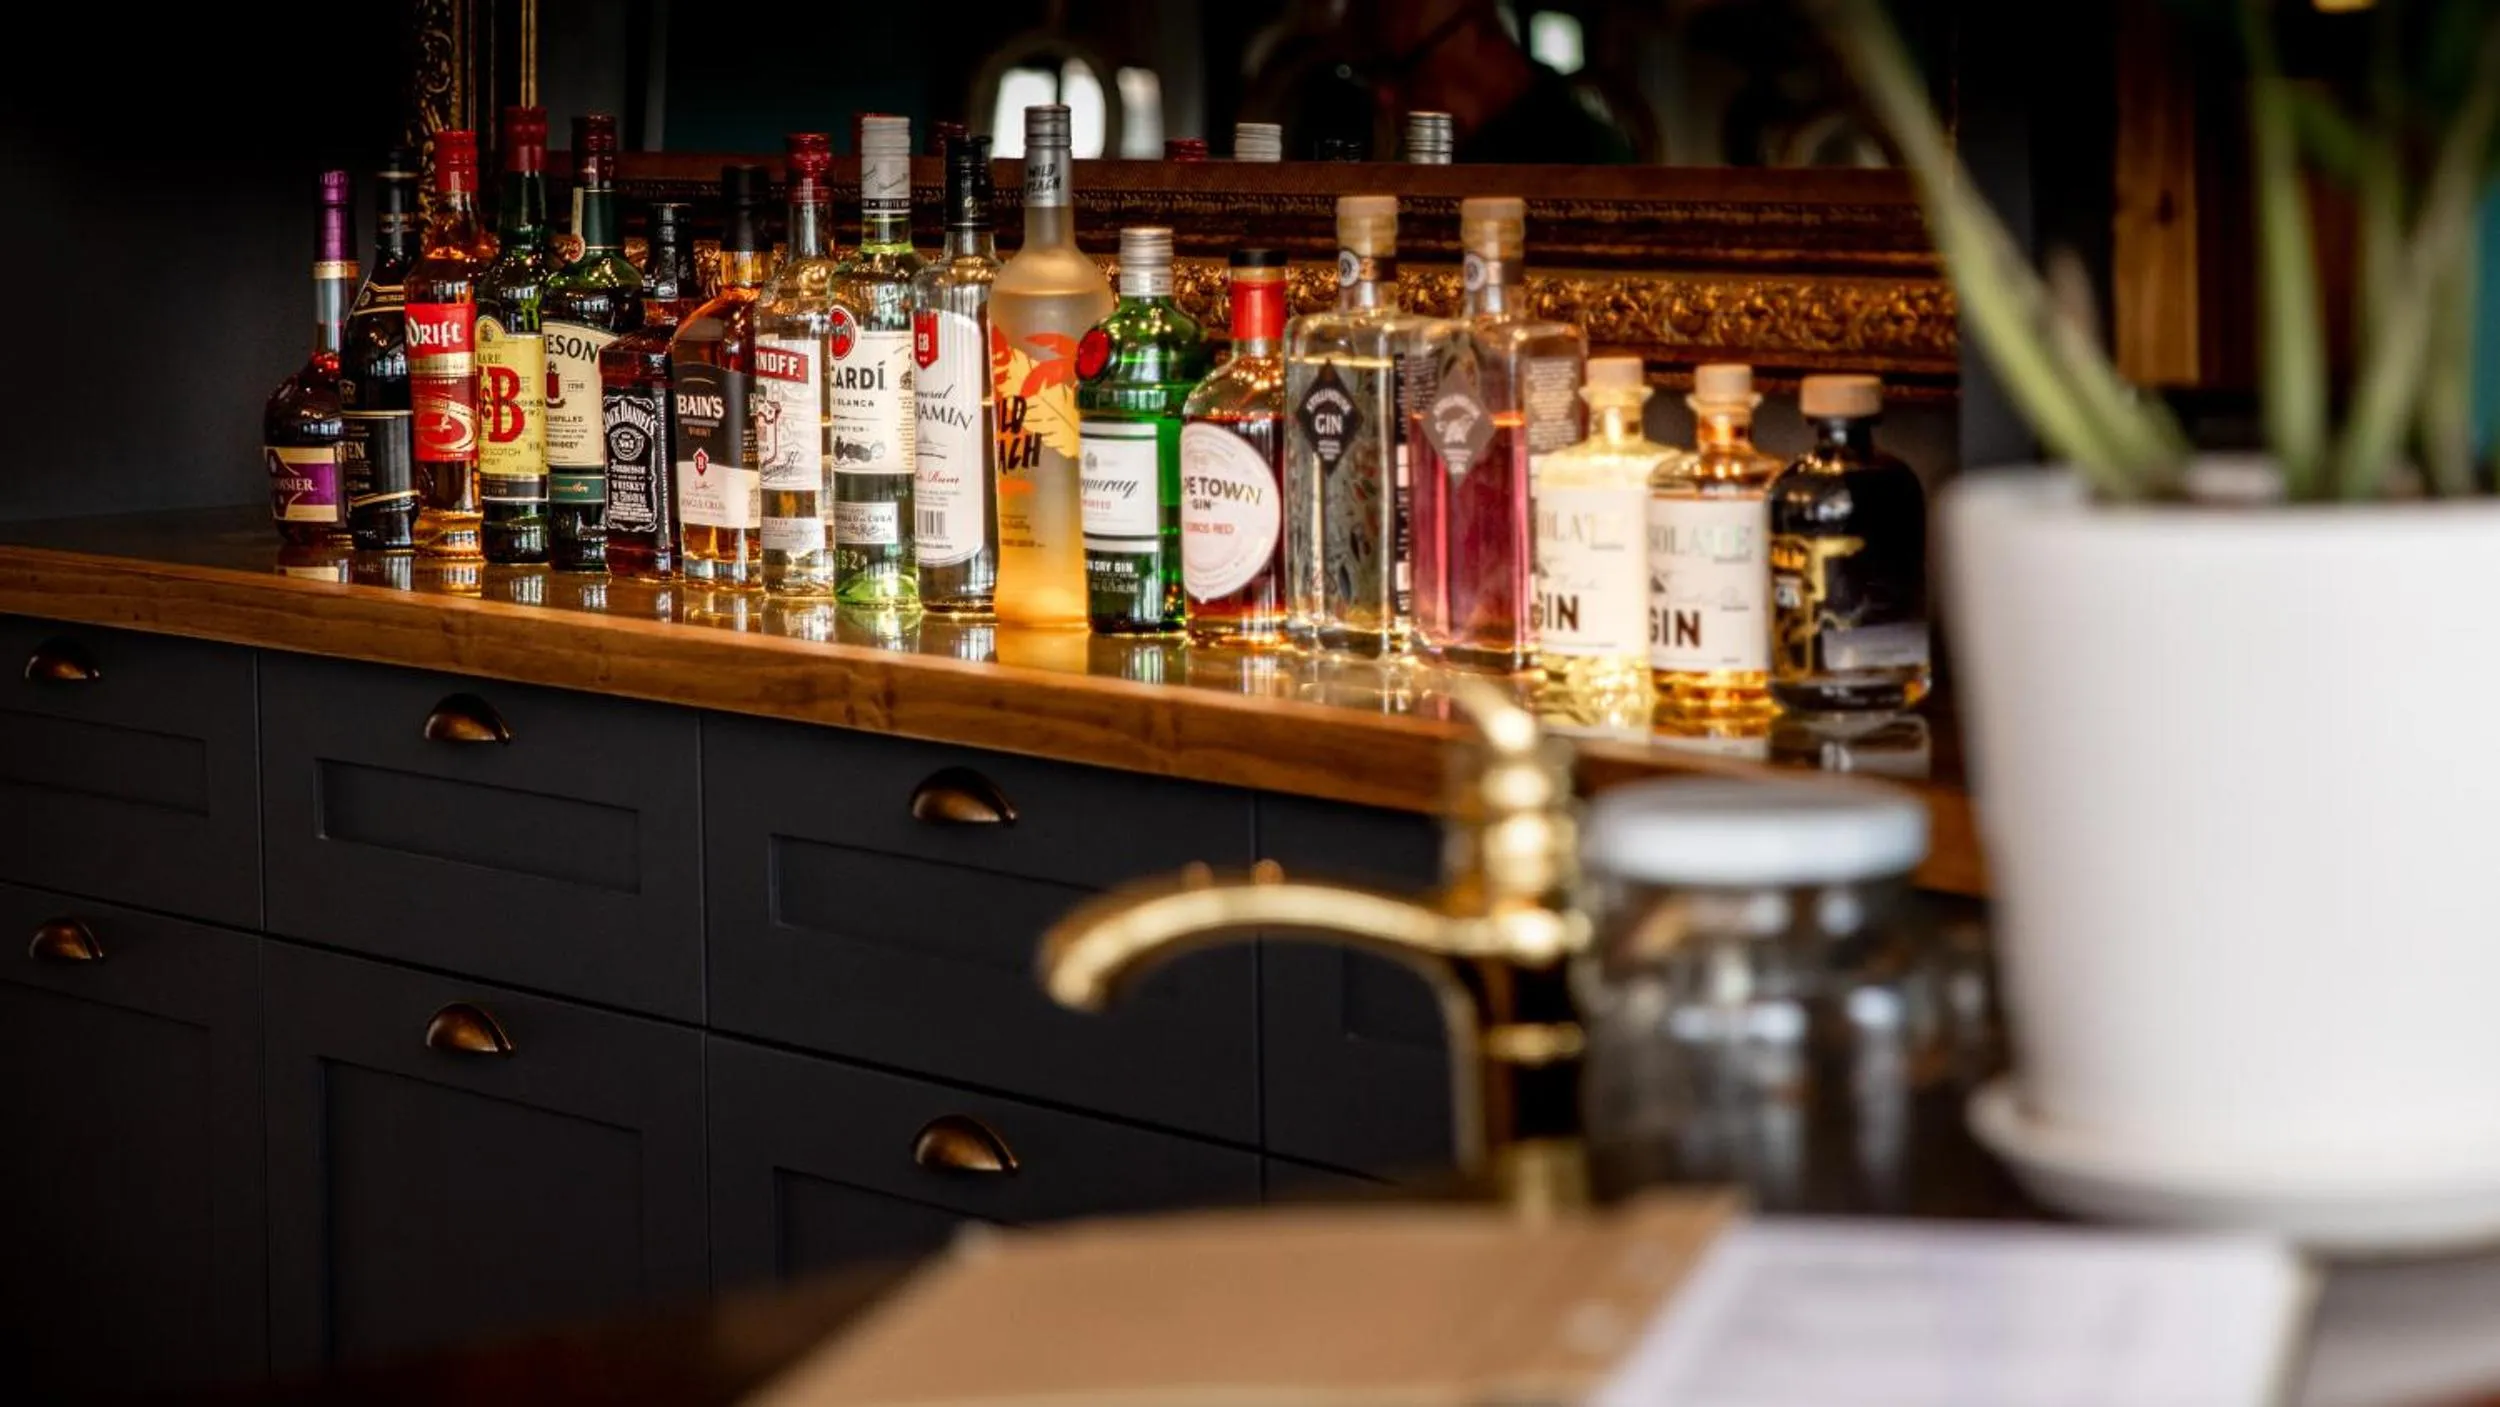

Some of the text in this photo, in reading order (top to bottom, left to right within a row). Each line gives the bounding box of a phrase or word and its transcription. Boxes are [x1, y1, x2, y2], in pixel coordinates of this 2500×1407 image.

[832, 360, 884, 391] ARDÍ
[676, 394, 724, 420] BAIN'S
[1313, 413, 1343, 436] GIN
[1199, 477, 1263, 506] TOWN
[1192, 499, 1212, 511] GIN
[1114, 561, 1134, 574] GIN
